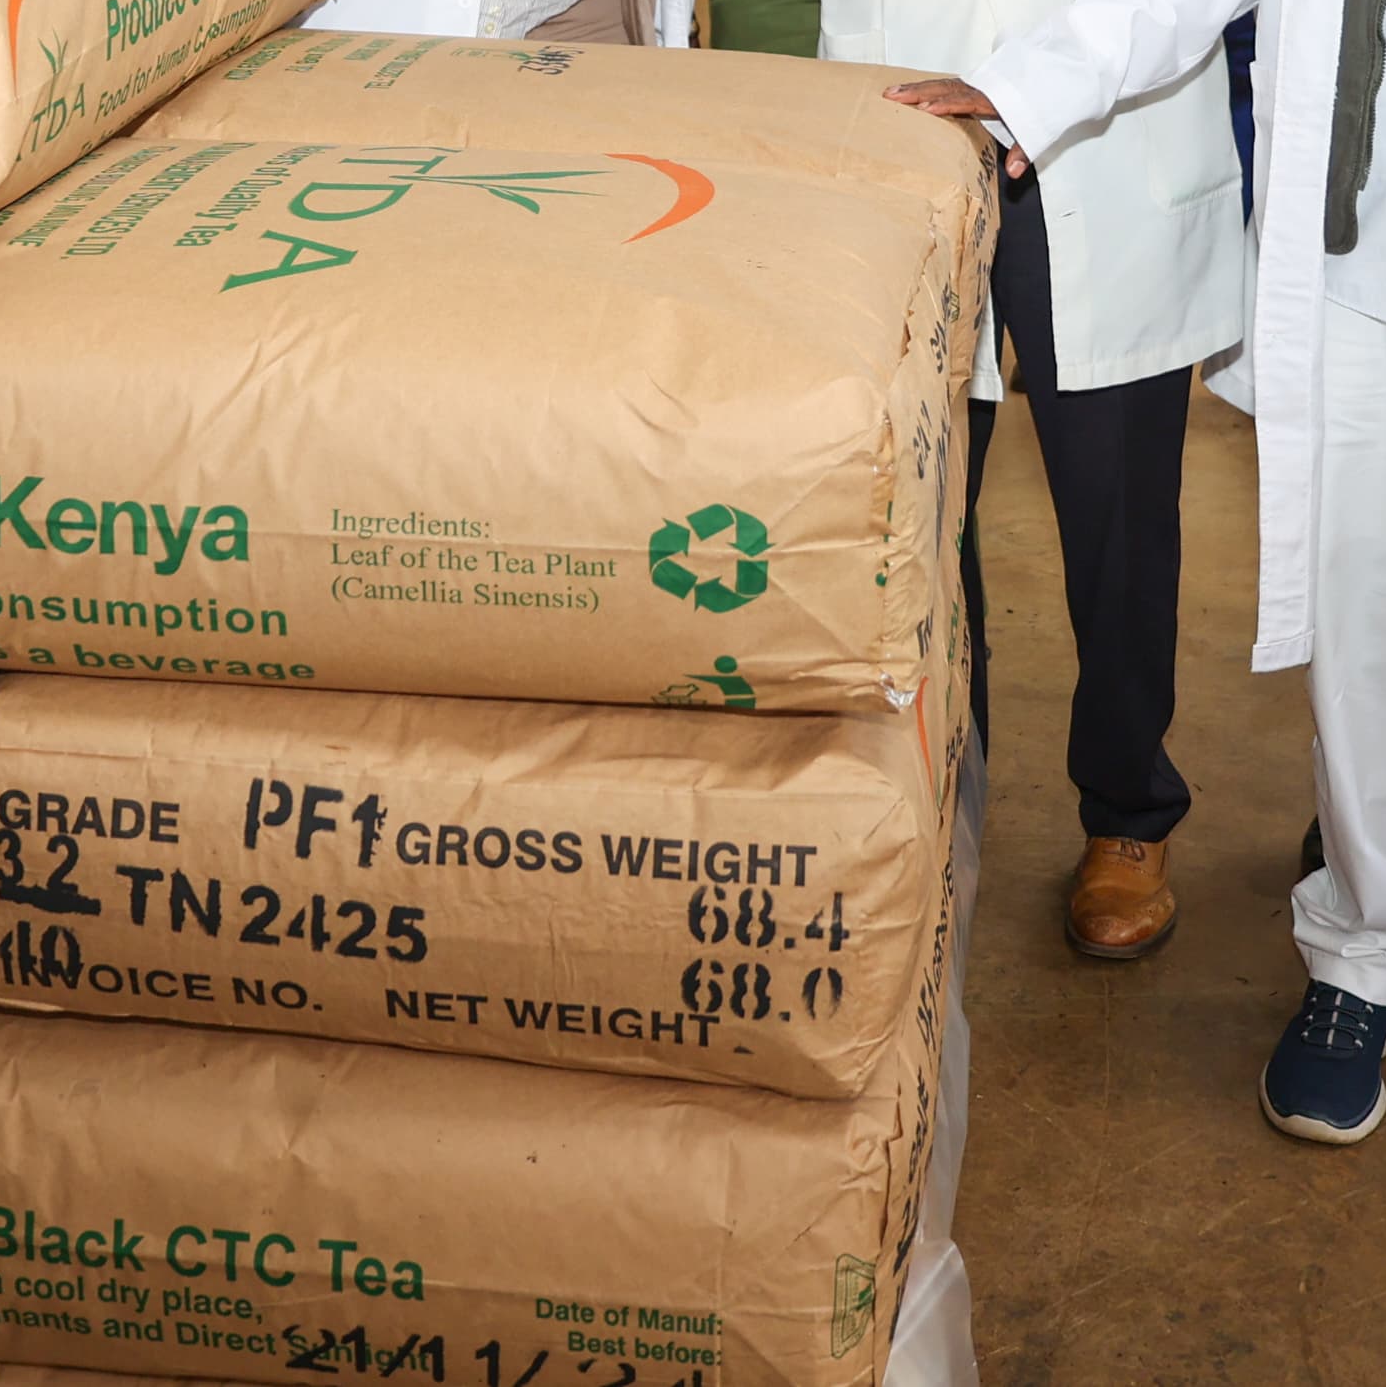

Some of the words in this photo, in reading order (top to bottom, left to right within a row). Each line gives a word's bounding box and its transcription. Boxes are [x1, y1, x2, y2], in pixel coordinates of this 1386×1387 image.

[95, 83, 131, 125] Food
[131, 65, 153, 98] for
[87, 192, 171, 234] SERVICES
[195, 177, 284, 220] Quality
[173, 222, 238, 248] Tea
[219, 146, 462, 294] TDA
[332, 508, 491, 540] Ingredients:
[331, 542, 394, 566] Leaf
[400, 547, 431, 569] of
[437, 548, 478, 571] the
[486, 550, 535, 575] Tea
[544, 553, 618, 577] Plant
[331, 576, 463, 604] (Camellia
[473, 583, 600, 613] Sinensis)
[28, 646, 55, 665] a
[73, 644, 315, 680] beverage
[244, 778, 388, 868] PF1
[396, 822, 583, 874] GROSS
[601, 834, 817, 887] WEIGHT
[687, 885, 850, 952] 68.4
[231, 977, 323, 1012] NO.
[681, 957, 844, 1021] 68.0
[385, 989, 488, 1025] NET
[504, 997, 720, 1048] WEIGHT
[166, 1225, 296, 1287] CTC
[318, 1239, 425, 1302] Tea
[15, 1275, 84, 1302] cool
[97, 1277, 150, 1314] dry
[162, 1289, 263, 1325] place,
[536, 1298, 595, 1324] Date
[604, 1305, 630, 1327] of
[637, 1311, 723, 1336] Manuf:
[103, 1314, 163, 1343] and
[176, 1322, 277, 1355] Direct
[568, 1331, 625, 1356] Best
[634, 1338, 723, 1366] before:
